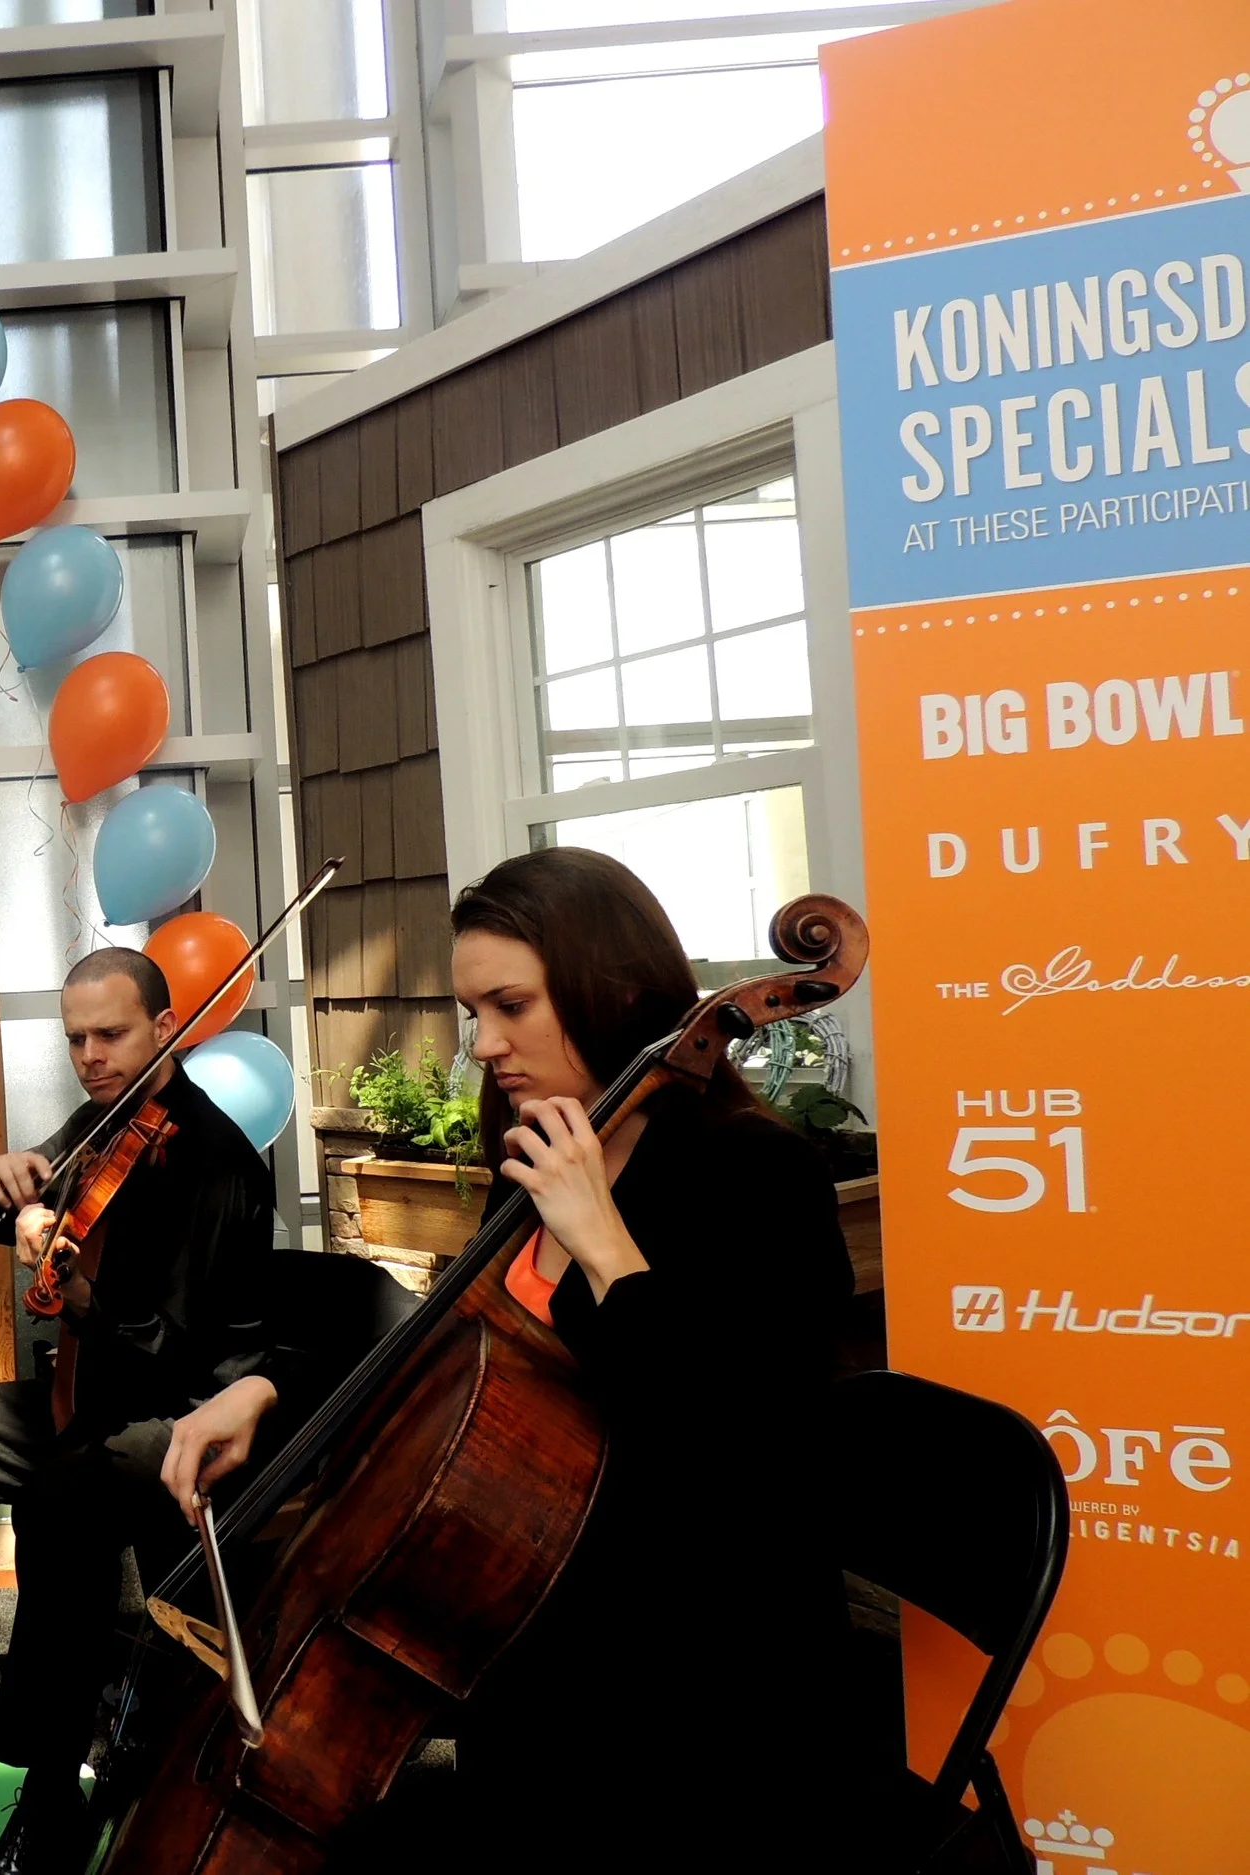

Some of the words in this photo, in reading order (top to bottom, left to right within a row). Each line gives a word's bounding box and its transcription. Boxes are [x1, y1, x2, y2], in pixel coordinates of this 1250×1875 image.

[903, 520, 940, 553] AT
[950, 507, 1049, 546] THESE
[919, 689, 1029, 760] BIG
[1046, 671, 1244, 750] BOWL
[927, 814, 1250, 878] DUFRY
[936, 982, 990, 999] THE
[956, 1088, 1082, 1117] HUB
[947, 1126, 1088, 1213] 51
[1122, 1504, 1140, 1516] BY
